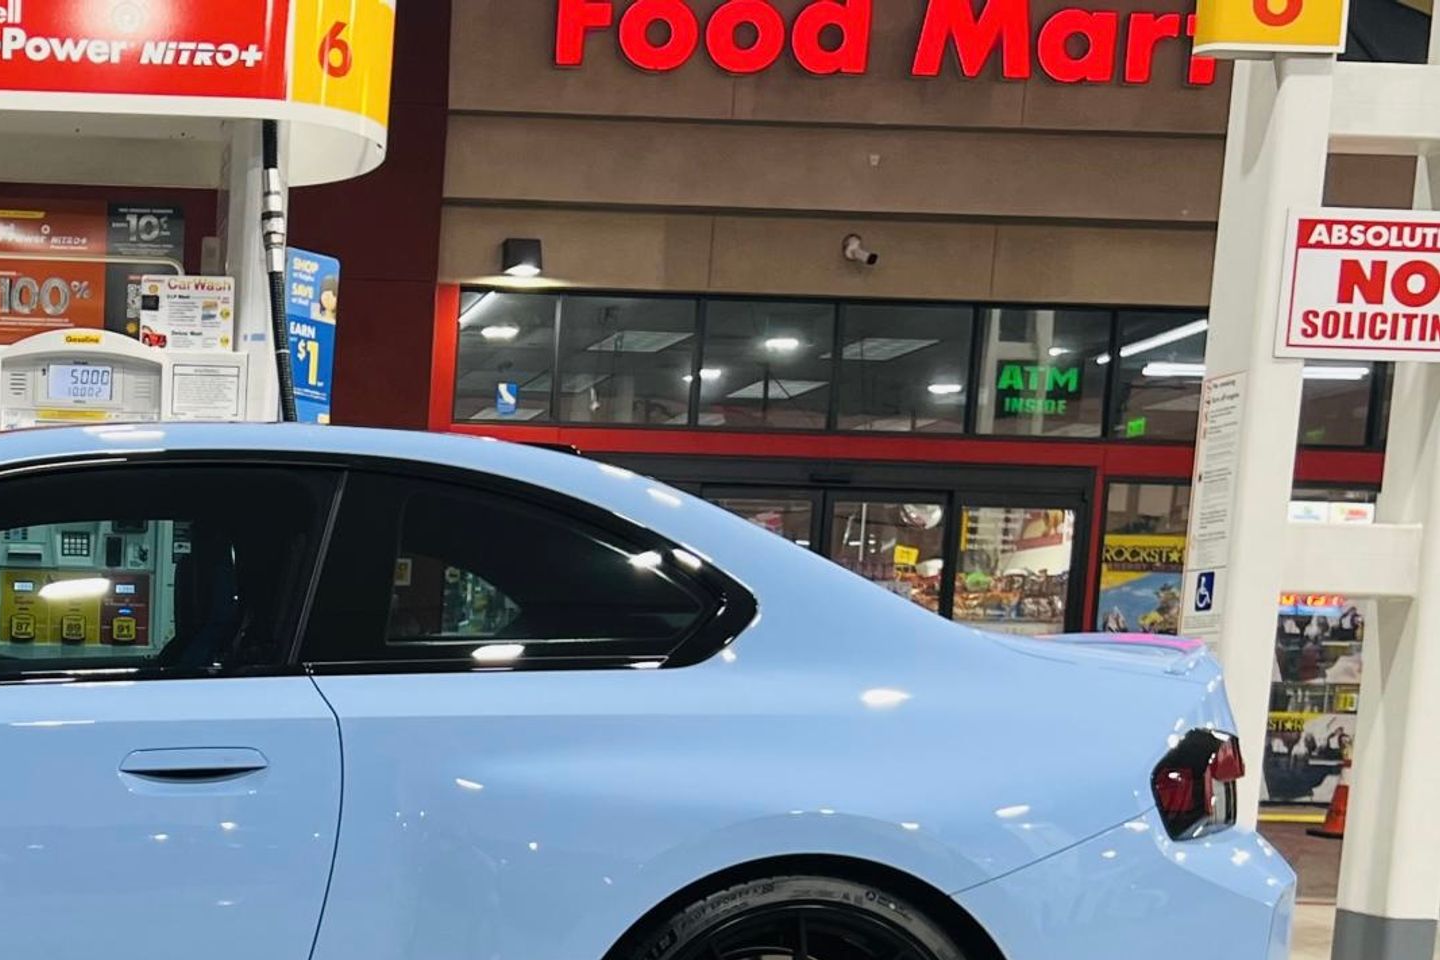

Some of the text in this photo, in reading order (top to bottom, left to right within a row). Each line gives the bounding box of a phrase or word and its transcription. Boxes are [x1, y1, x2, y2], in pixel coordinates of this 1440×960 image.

[318, 21, 352, 78] 6
[555, 0, 872, 74] Food
[1308, 223, 1440, 248] ABSOLUT
[1337, 259, 1440, 307] NO
[290, 321, 316, 339] EARN
[997, 365, 1079, 392] ATM
[1003, 397, 1067, 415] INSIDE
[16, 623, 30, 632] 87
[117, 624, 131, 633] 91
